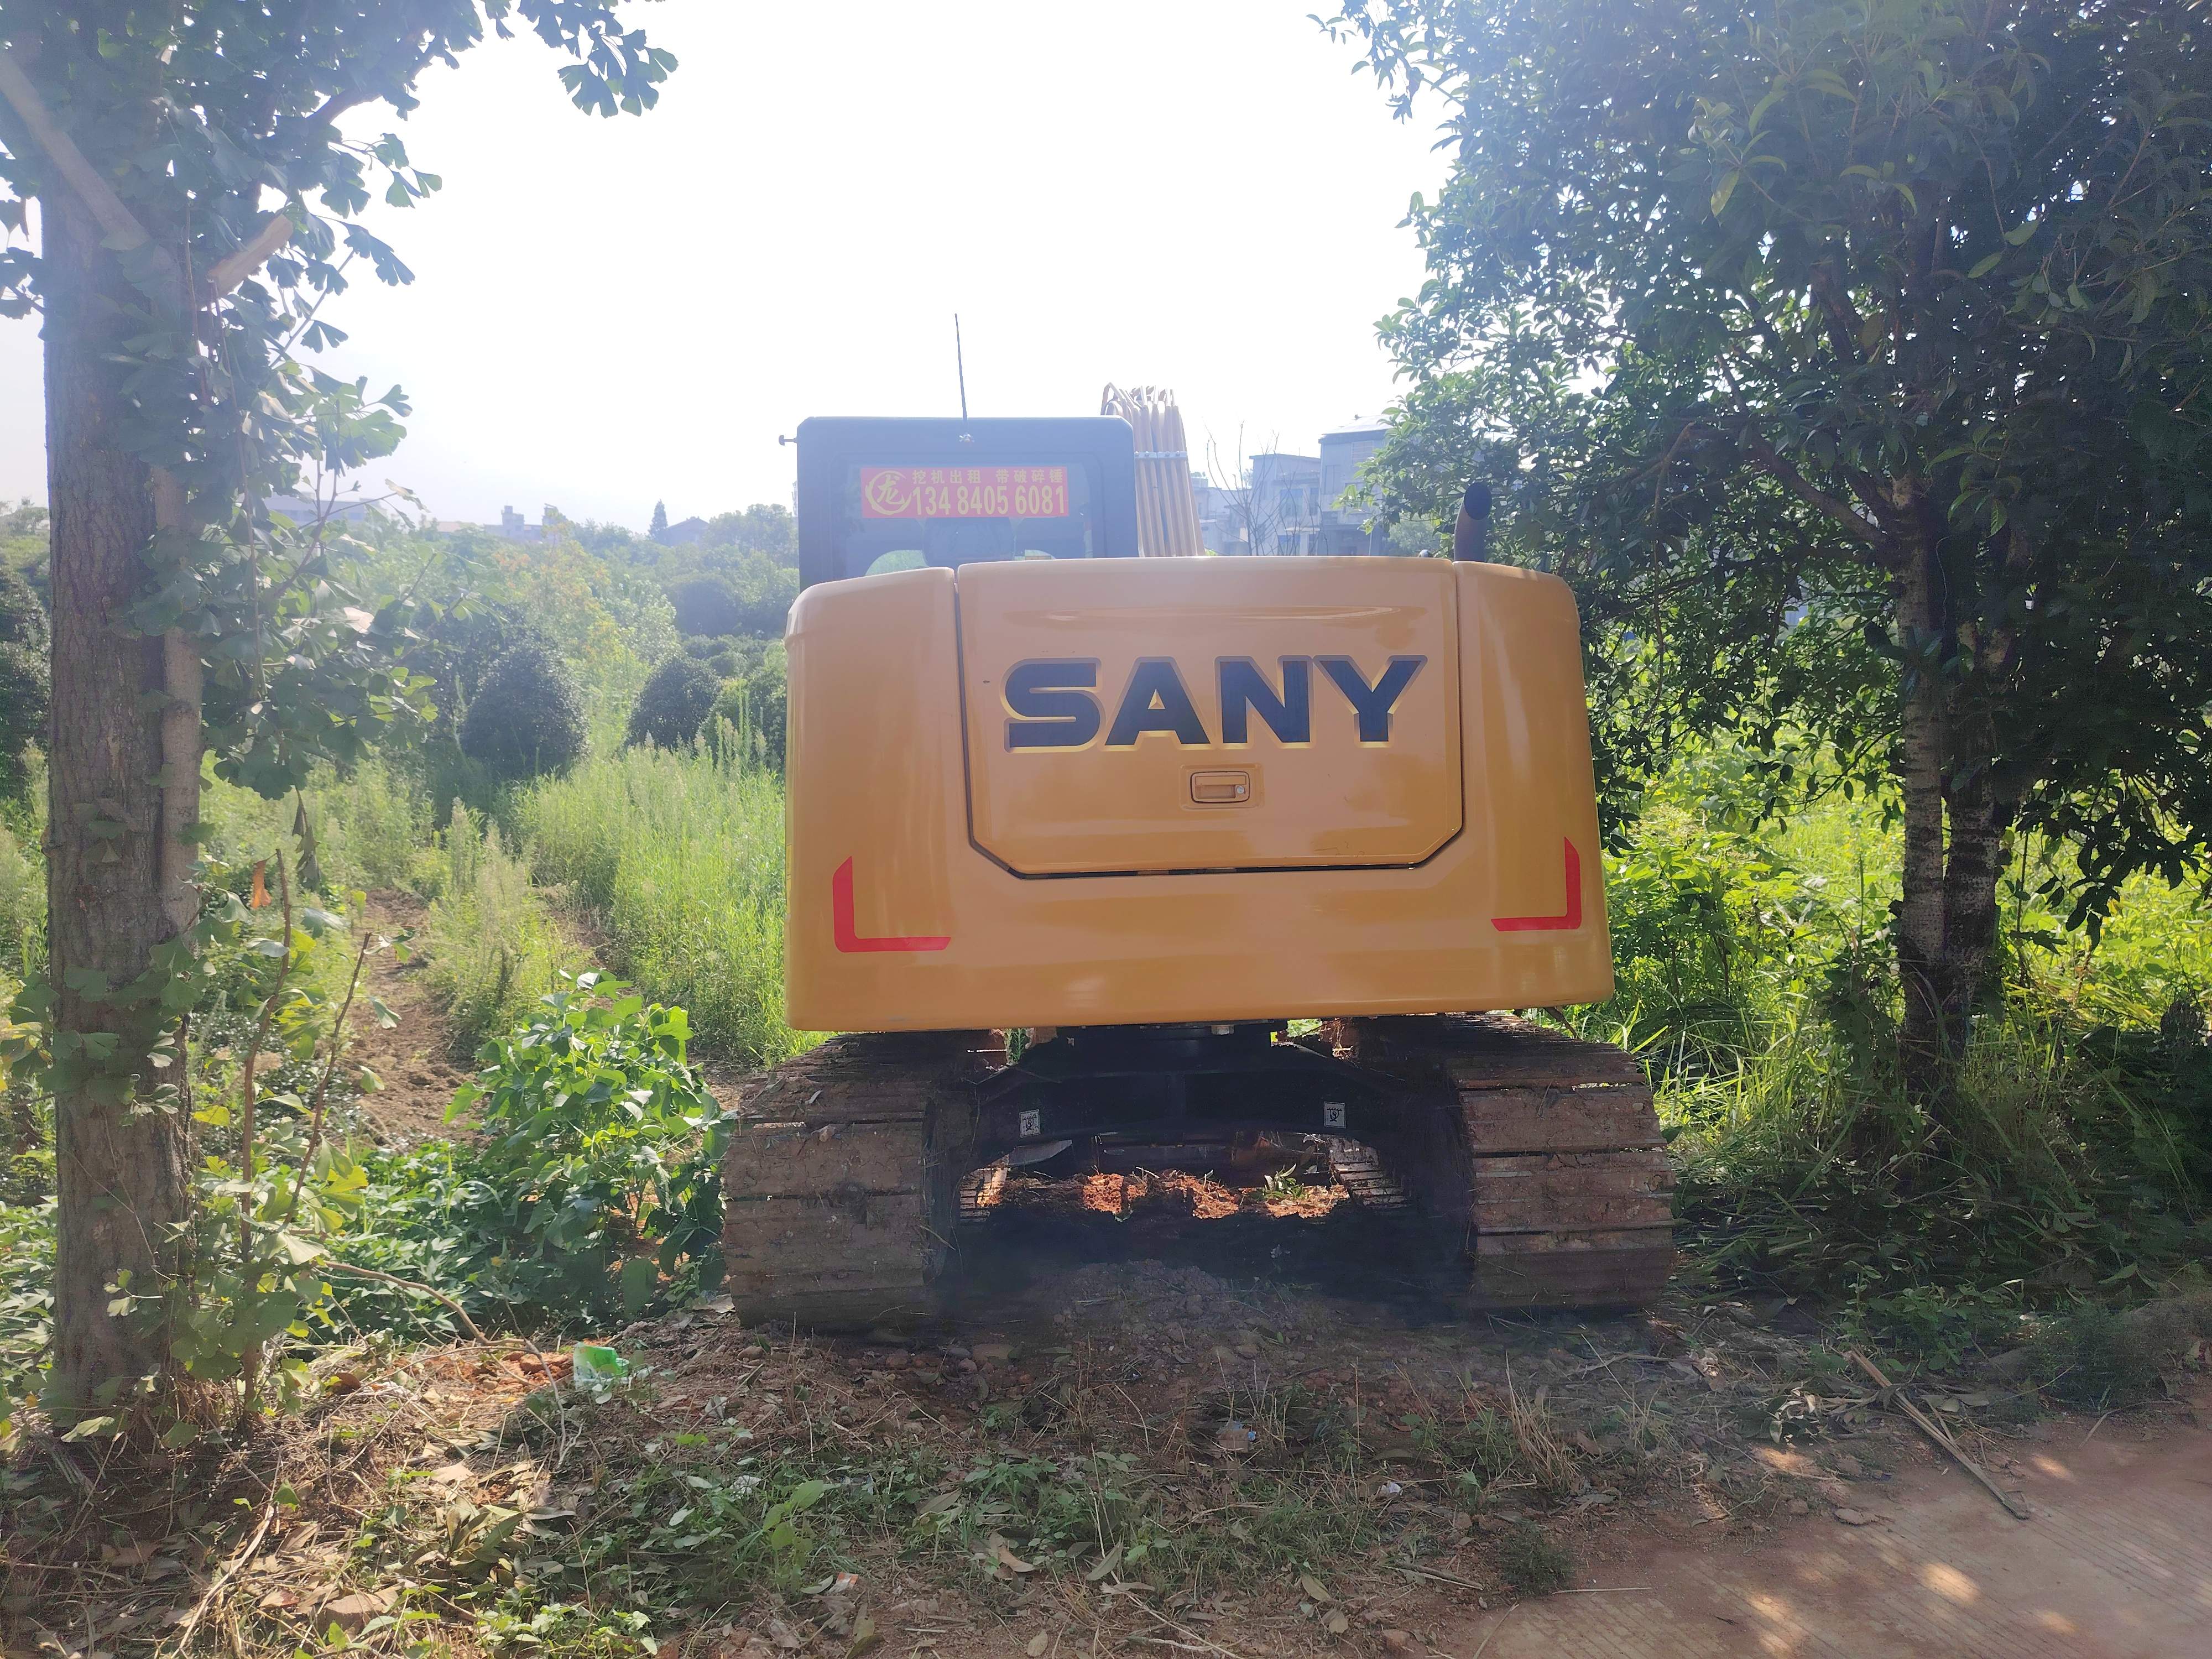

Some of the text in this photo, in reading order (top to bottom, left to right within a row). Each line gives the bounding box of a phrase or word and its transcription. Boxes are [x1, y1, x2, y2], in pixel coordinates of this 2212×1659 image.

[878, 474, 905, 505] 龙
[912, 469, 1063, 484] 挖机出租 带破碎锤
[912, 485, 1064, 515] 134 8405 6081
[1001, 656, 1427, 752] SANY
